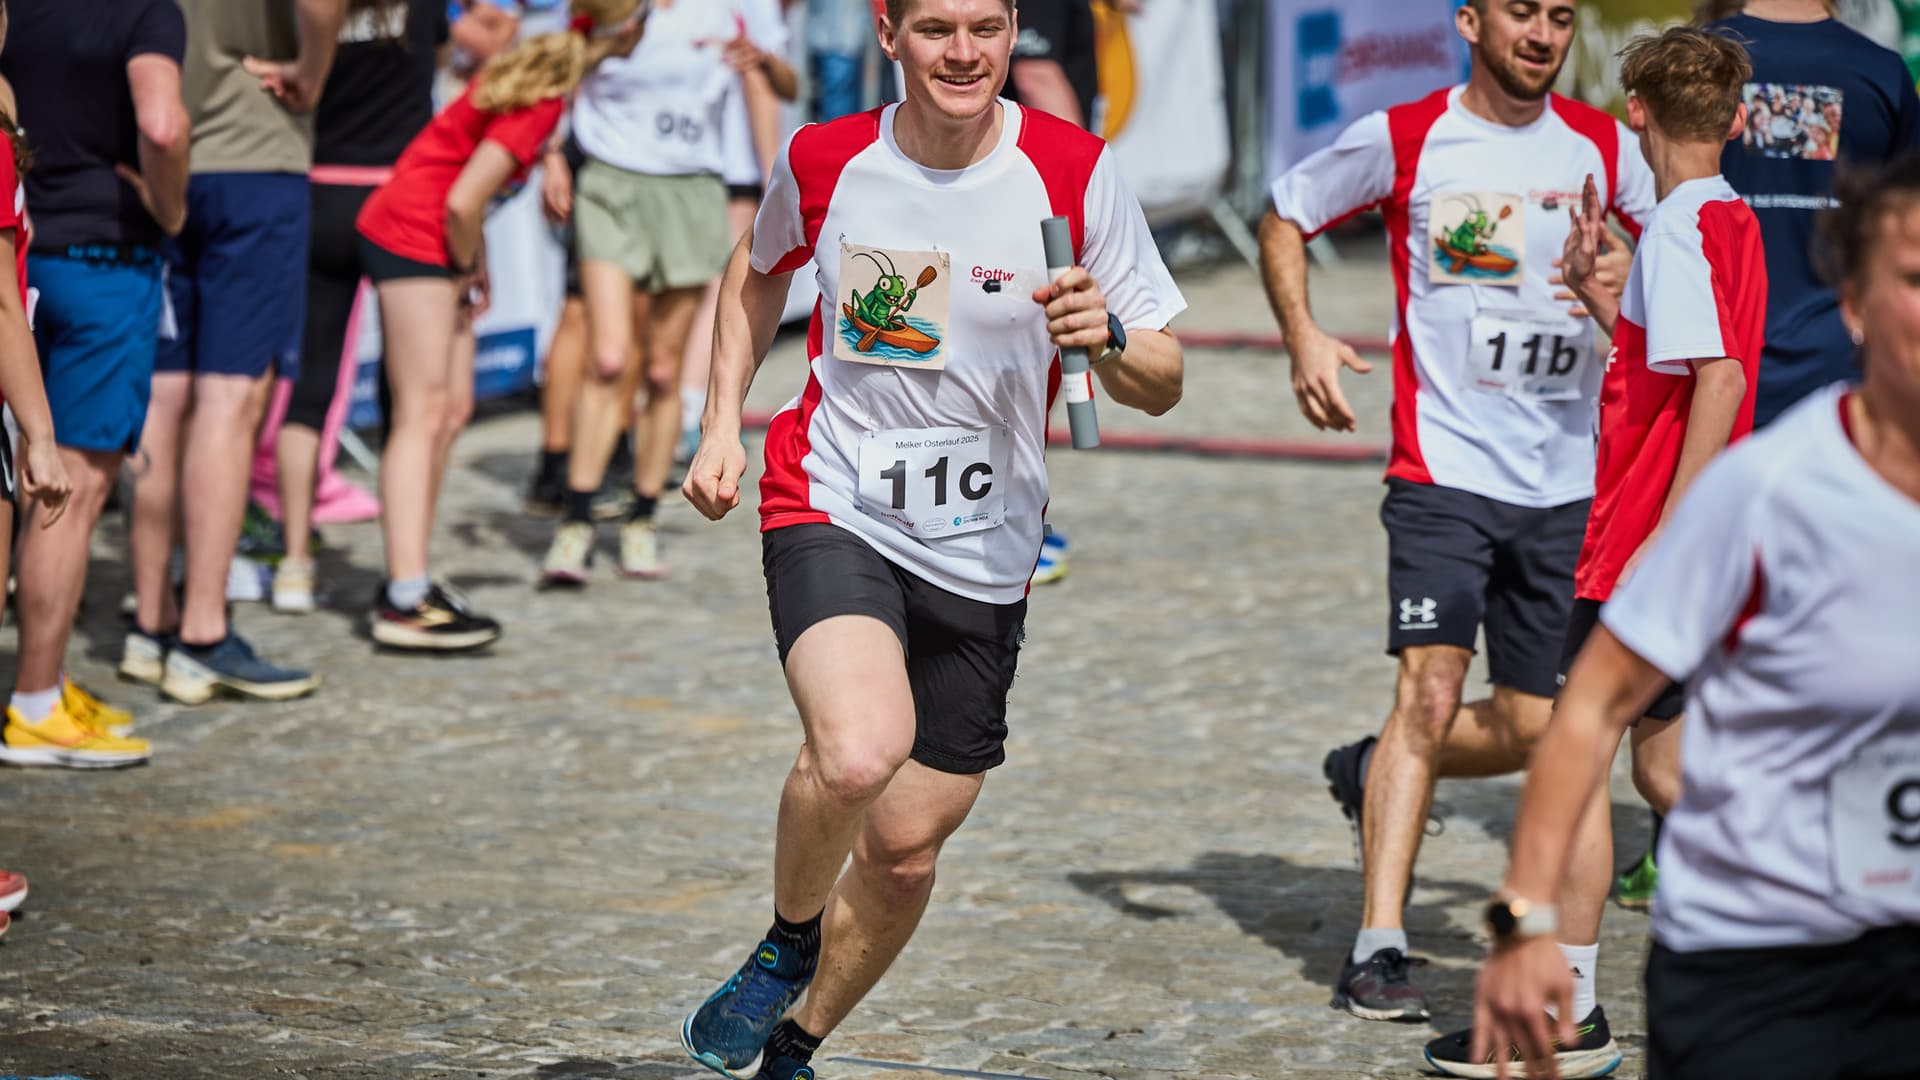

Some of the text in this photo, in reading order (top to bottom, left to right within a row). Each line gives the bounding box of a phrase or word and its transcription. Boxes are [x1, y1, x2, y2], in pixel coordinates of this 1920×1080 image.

[971, 265, 1014, 281] Gottw
[1487, 331, 1578, 376] 11b
[895, 434, 980, 449] Melker Osterlauf 2025
[880, 456, 993, 510] 11c
